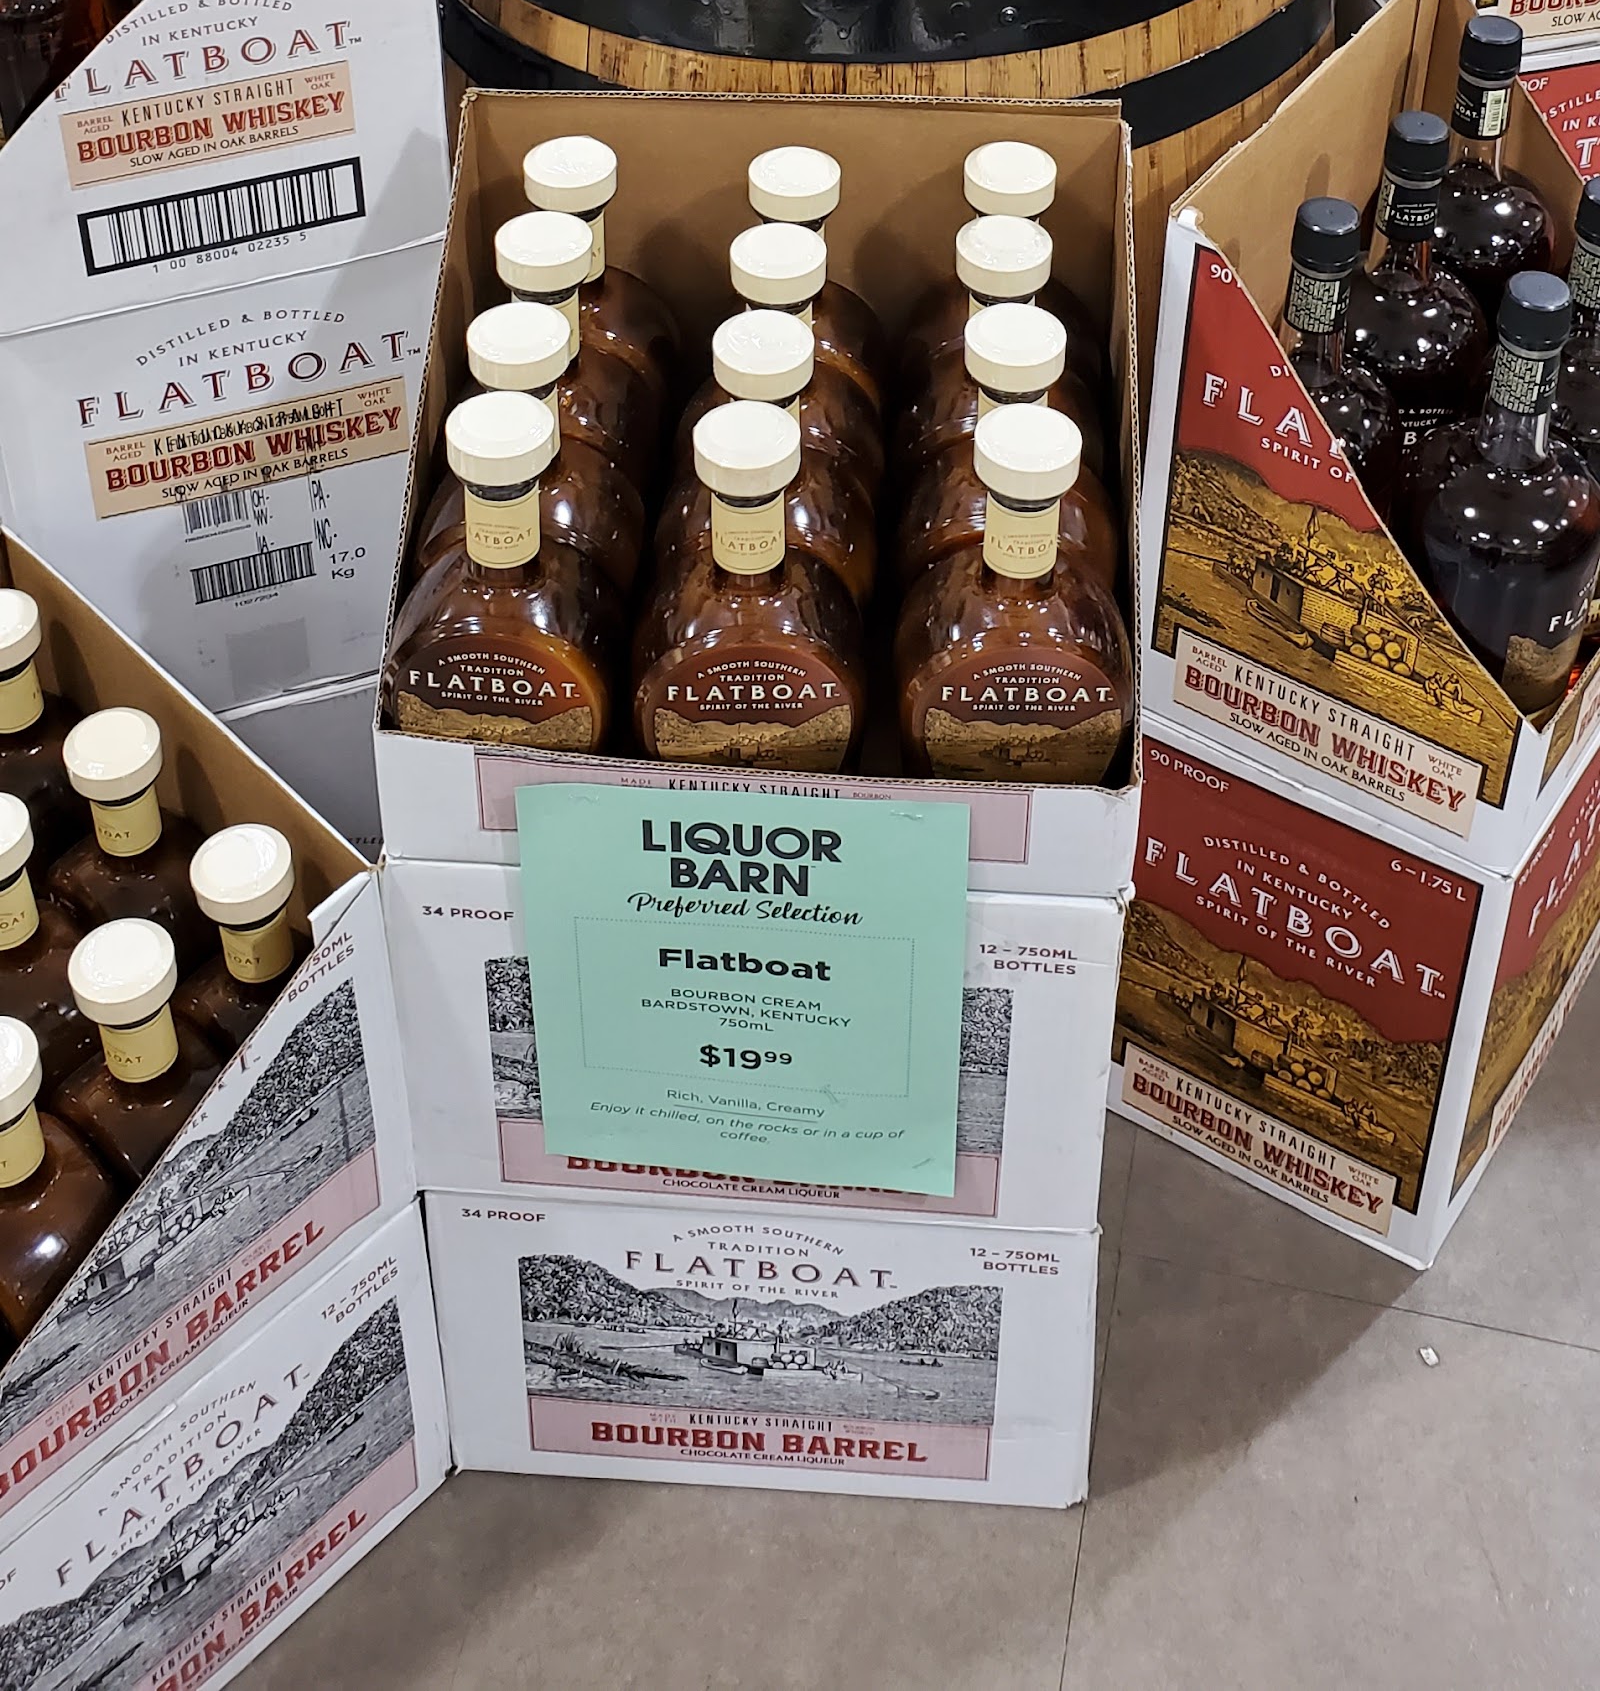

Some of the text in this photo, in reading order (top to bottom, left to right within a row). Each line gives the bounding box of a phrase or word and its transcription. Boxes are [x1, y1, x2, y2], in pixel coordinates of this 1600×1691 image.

[104, 2, 189, 45] DISTILLED
[198, 0, 210, 9] &
[142, 16, 259, 47] IN KENTUCKY
[121, 78, 295, 127] KENTUCKY STRAIGHT
[77, 115, 114, 128] BARREL
[77, 92, 346, 164] BOURBON WHISKEY
[84, 124, 110, 135] AGED
[129, 125, 299, 168] SLOW AGED IN OAK BARRELS
[152, 232, 308, 273] 1 00 88004 02235 5
[77, 330, 410, 427] FLATBOAT
[106, 406, 402, 492] BOURBON WHISKEY
[329, 547, 366, 564] 17.0
[332, 568, 355, 579] Kg
[438, 652, 546, 675] A SMOOTH SOUTHERN
[460, 665, 524, 677] TRADITION
[409, 670, 576, 699] FLATBOAT
[667, 682, 837, 701] FLATBOAT
[941, 686, 1111, 703] FLATBOAT
[1234, 662, 1416, 762] KENTUCKY STRAIGHT
[1184, 663, 1466, 812] BOURBON WHISKEY
[1150, 749, 1230, 794] 90 PROOF
[641, 819, 843, 863] LIQUOR
[669, 857, 810, 897] BARN
[422, 905, 515, 921] 34 PROOF
[627, 891, 864, 926] Preferred Selection
[1144, 835, 1447, 998] FLATBOAT
[658, 947, 832, 981] Flatboat
[978, 943, 1078, 961] 12 750ML
[993, 958, 1077, 976] BOTTLES
[641, 998, 852, 1029] BARDSTOWN, KENTUCKY
[671, 988, 822, 1011] BOURBON CREAM
[719, 1017, 774, 1032] 750mL
[590, 1101, 905, 1143] Enjoy it chilled, on the rocks or in a cup of
[708, 1094, 763, 1111] Vanilla,
[765, 1101, 825, 1119] Creamy
[719, 1128, 771, 1145] coffee.
[663, 1177, 840, 1200] CHOCOLATE CREAM LIQUEUR
[461, 1208, 546, 1222] 34 PROOF
[672, 1225, 845, 1256] A SMOOTH SOUTHERN
[707, 1241, 810, 1257] TRADITION
[969, 1247, 1060, 1263] 12 750ML
[186, 1219, 327, 1344] BARREL
[625, 1250, 893, 1289] FLATBOAT
[983, 1261, 1059, 1276] BOTTLES
[320, 1254, 398, 1320] 12 750ML
[335, 1266, 400, 1325] BOTTLES
[676, 1279, 840, 1299] SPIRIT OF THE RIVER
[591, 1421, 928, 1462] BOURBON BARREL
[56, 1364, 304, 1588] FLATBOAT
